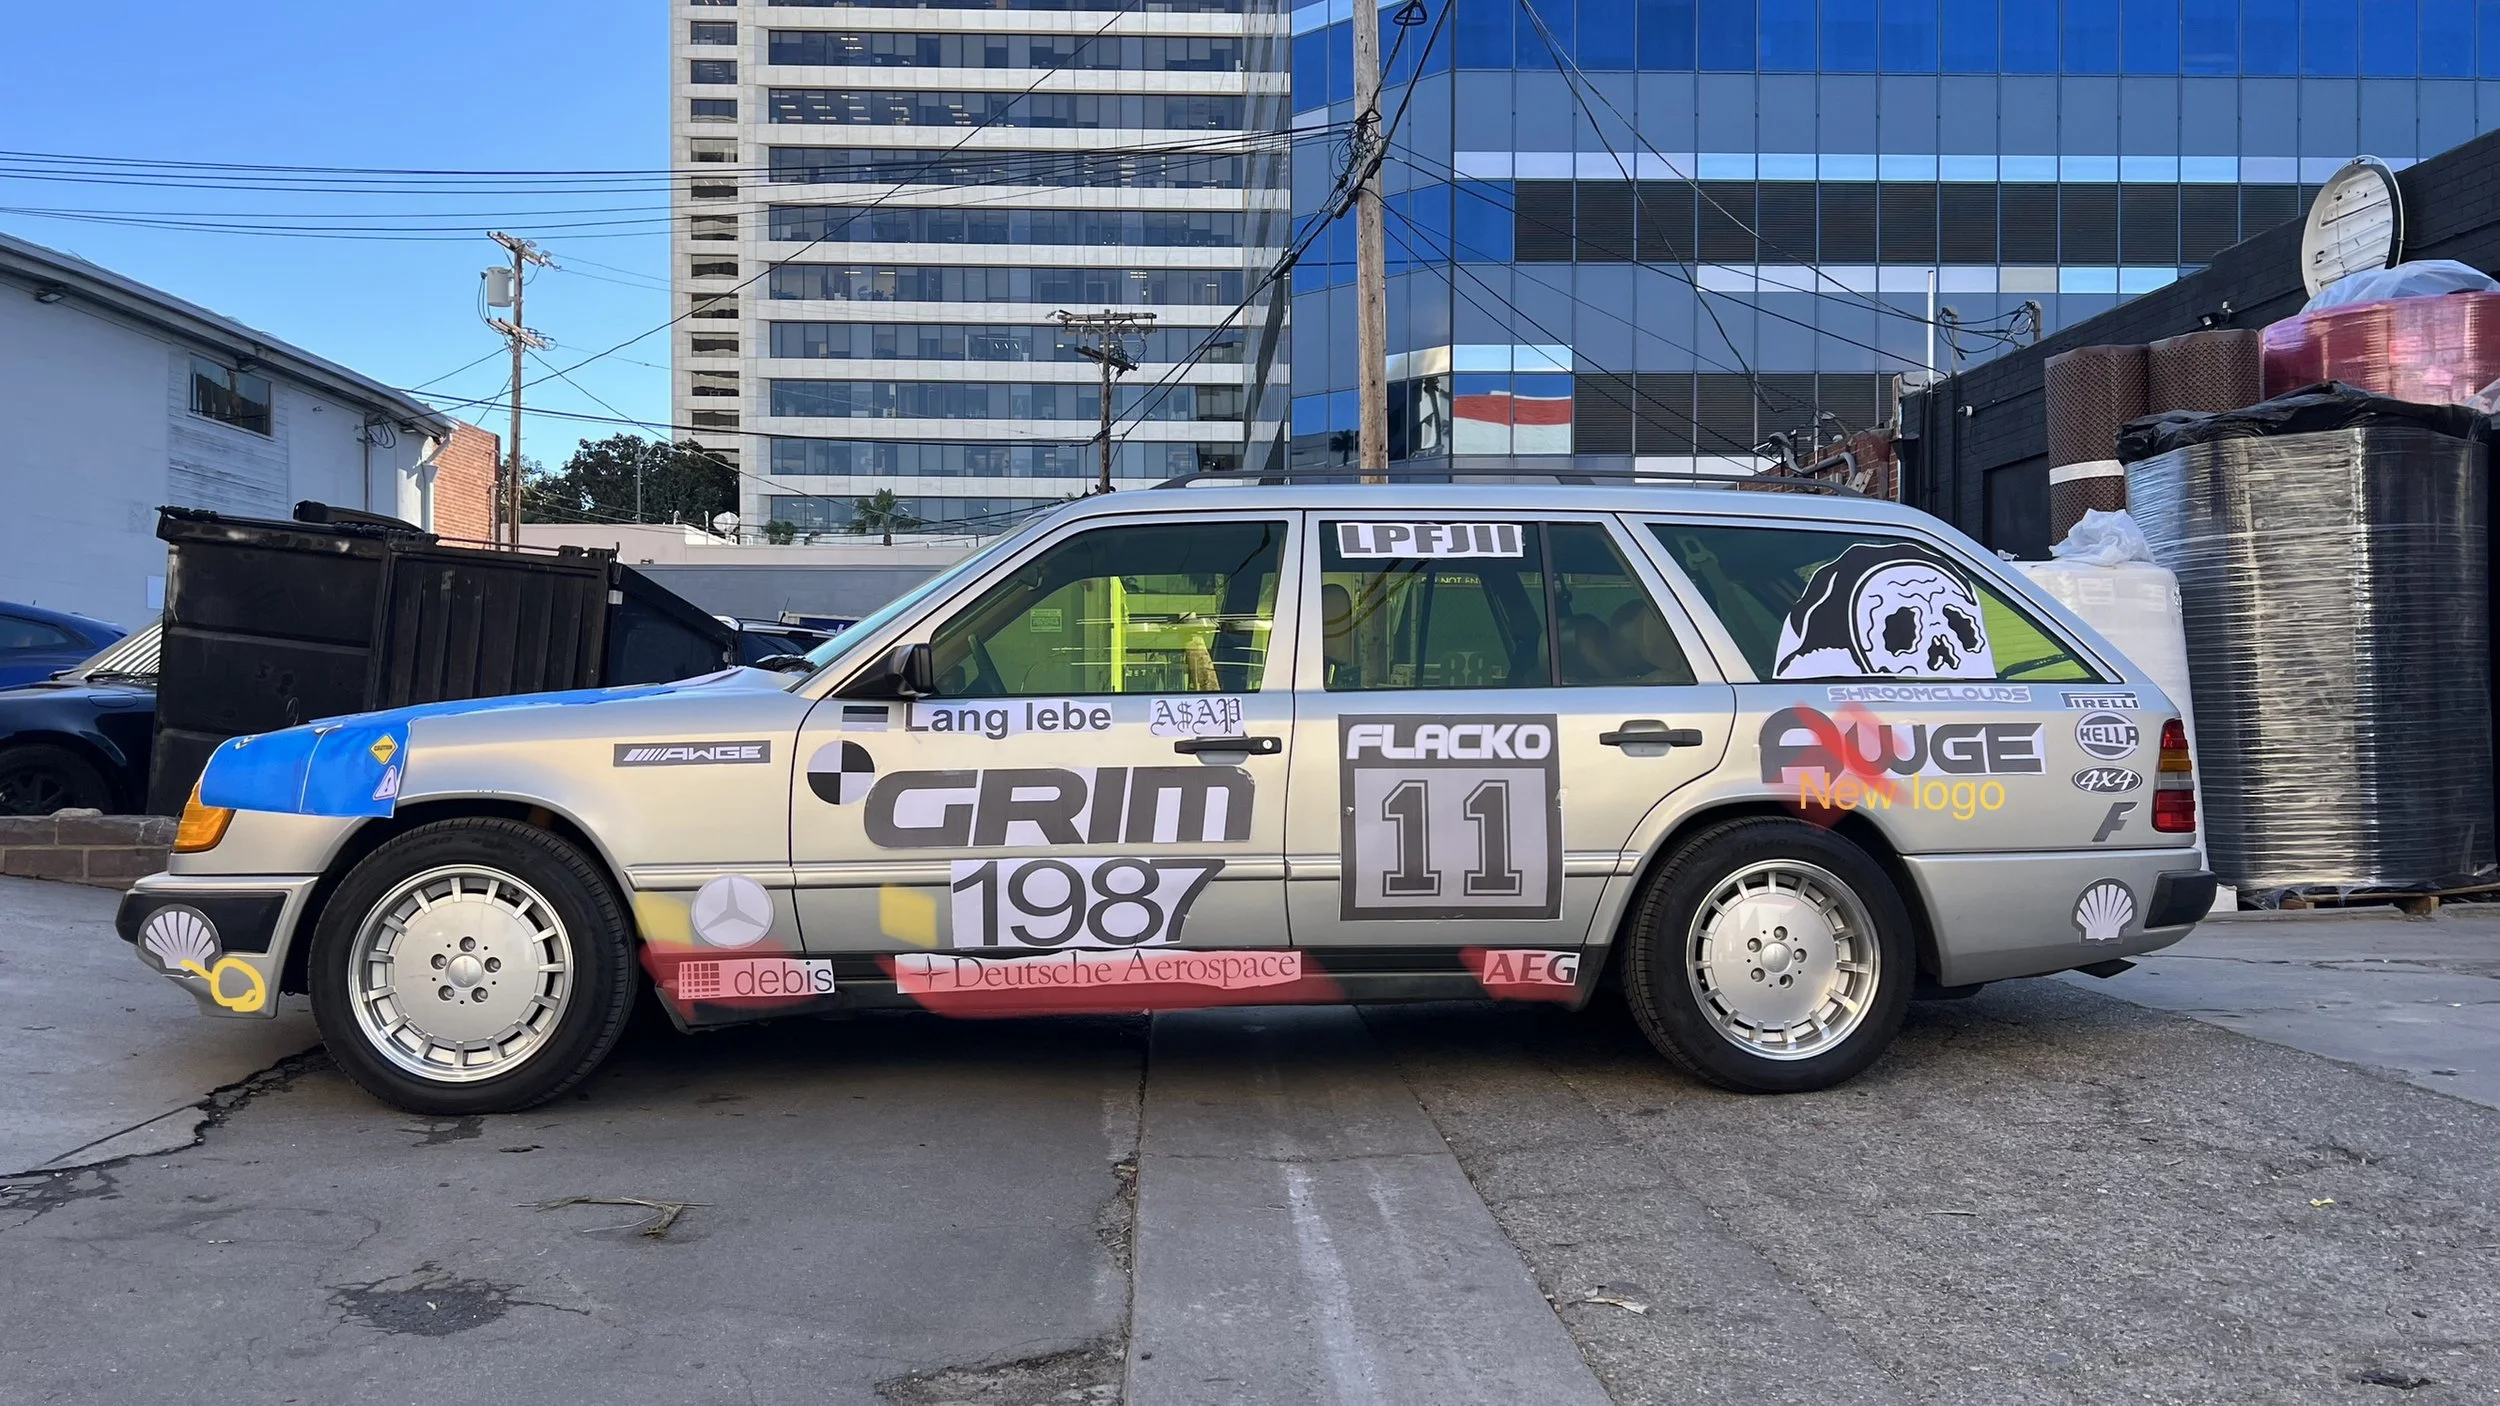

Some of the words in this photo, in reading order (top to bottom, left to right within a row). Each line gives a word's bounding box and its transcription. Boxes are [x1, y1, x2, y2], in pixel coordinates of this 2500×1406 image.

[1340, 524, 1518, 554] LPFJII
[1828, 685, 2030, 702] SHROOMCLOUDS
[2061, 692, 2139, 709] PIRELLI
[904, 701, 1009, 740] Lang
[1026, 701, 1112, 731] lebe
[1151, 697, 1242, 735] A$AP
[1346, 723, 1552, 760] FLACKO
[1759, 707, 2044, 785] AWGE
[2079, 726, 2140, 746] HELLA
[863, 765, 1255, 848] GRIM
[1381, 778, 1522, 897] 11
[952, 858, 1226, 948] 1987
[734, 960, 833, 995] debis
[953, 952, 1112, 989] Deutsche
[1122, 950, 1296, 983] Aerospace
[1485, 953, 1577, 984] AEG
